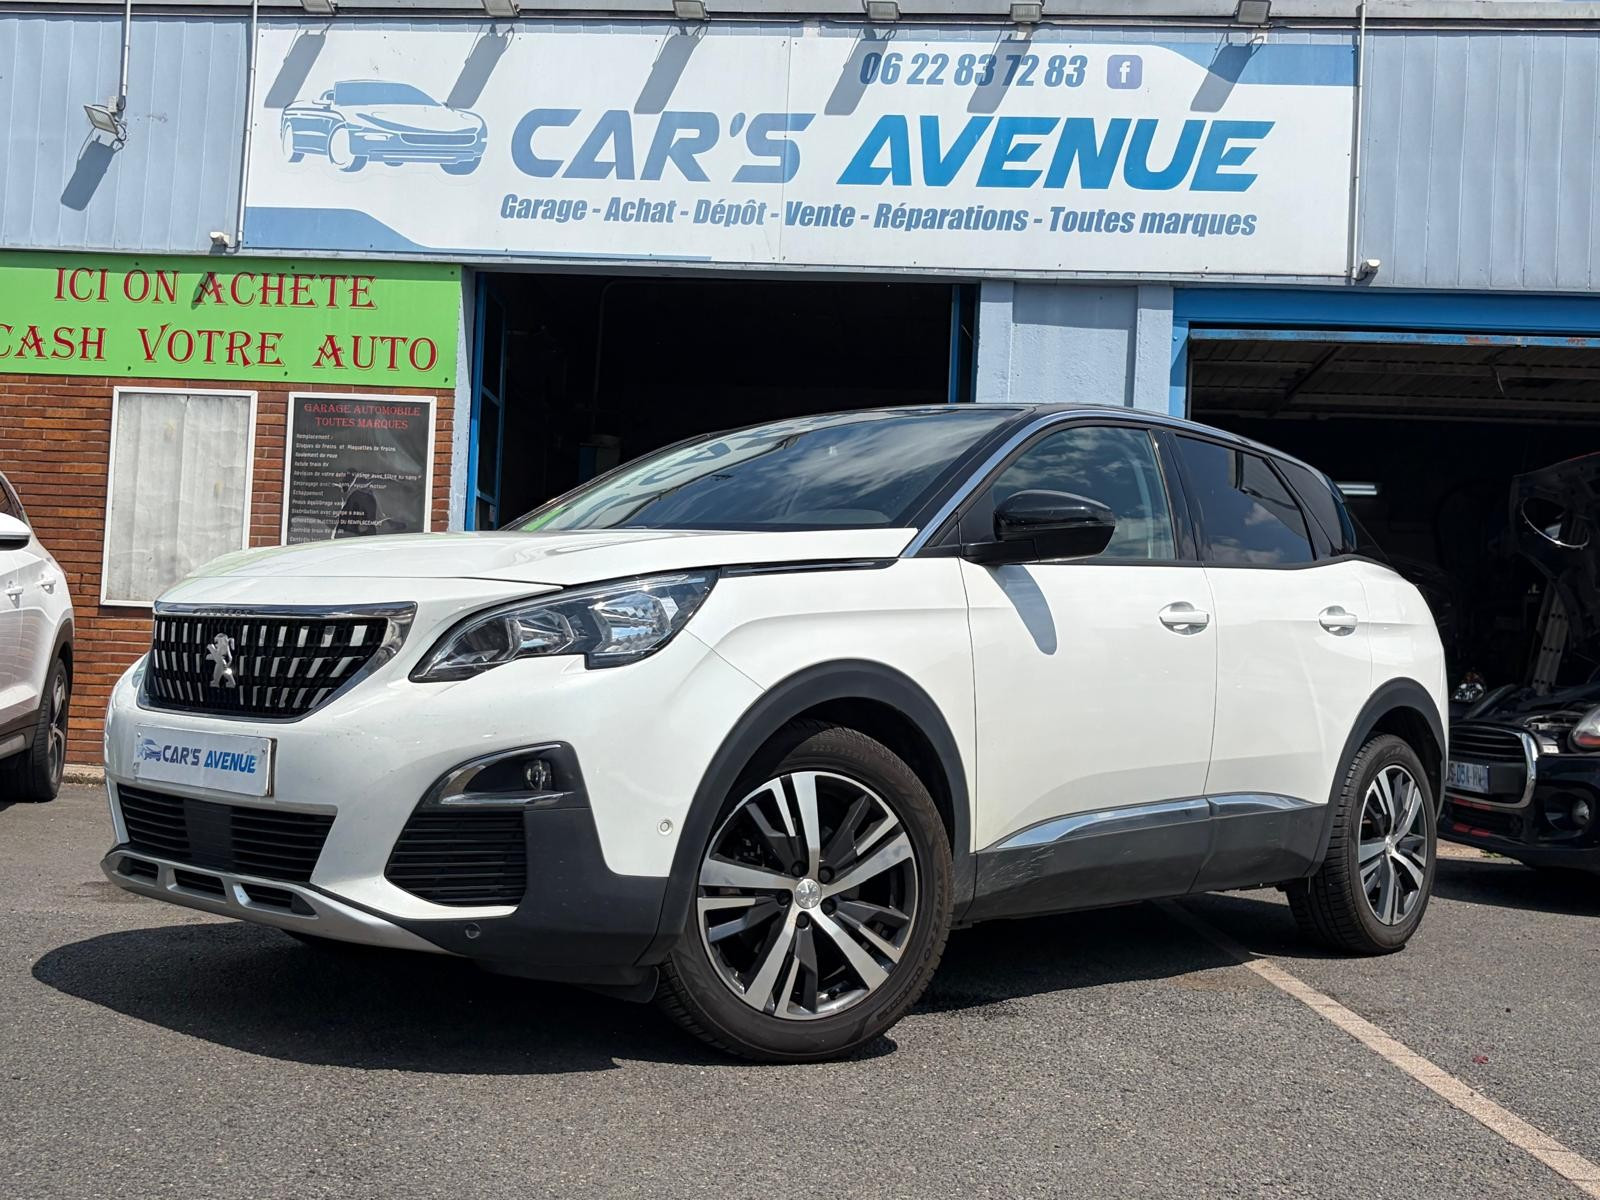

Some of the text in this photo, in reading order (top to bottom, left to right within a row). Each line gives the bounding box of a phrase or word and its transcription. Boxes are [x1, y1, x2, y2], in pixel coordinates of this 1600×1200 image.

[860, 52, 1088, 87] 06 22 83 72 83
[511, 108, 1276, 192] CAR'S AVENUE
[500, 193, 588, 223] Garage
[603, 197, 676, 224] Achat
[693, 198, 766, 227] Dépôt
[784, 201, 855, 228] Vente
[873, 202, 1029, 232] Réparations
[1049, 206, 1135, 234] Toutes
[1139, 209, 1257, 237] marques
[54, 267, 377, 309] ICI ON ACHETE
[137, 322, 286, 368] VOTRE
[312, 334, 439, 371] AUTO
[304, 403, 421, 417] GARAGE AUTOMOBILE
[315, 416, 409, 430] TOUTES MARQUES
[162, 745, 257, 774] CAR'S AVENUE
